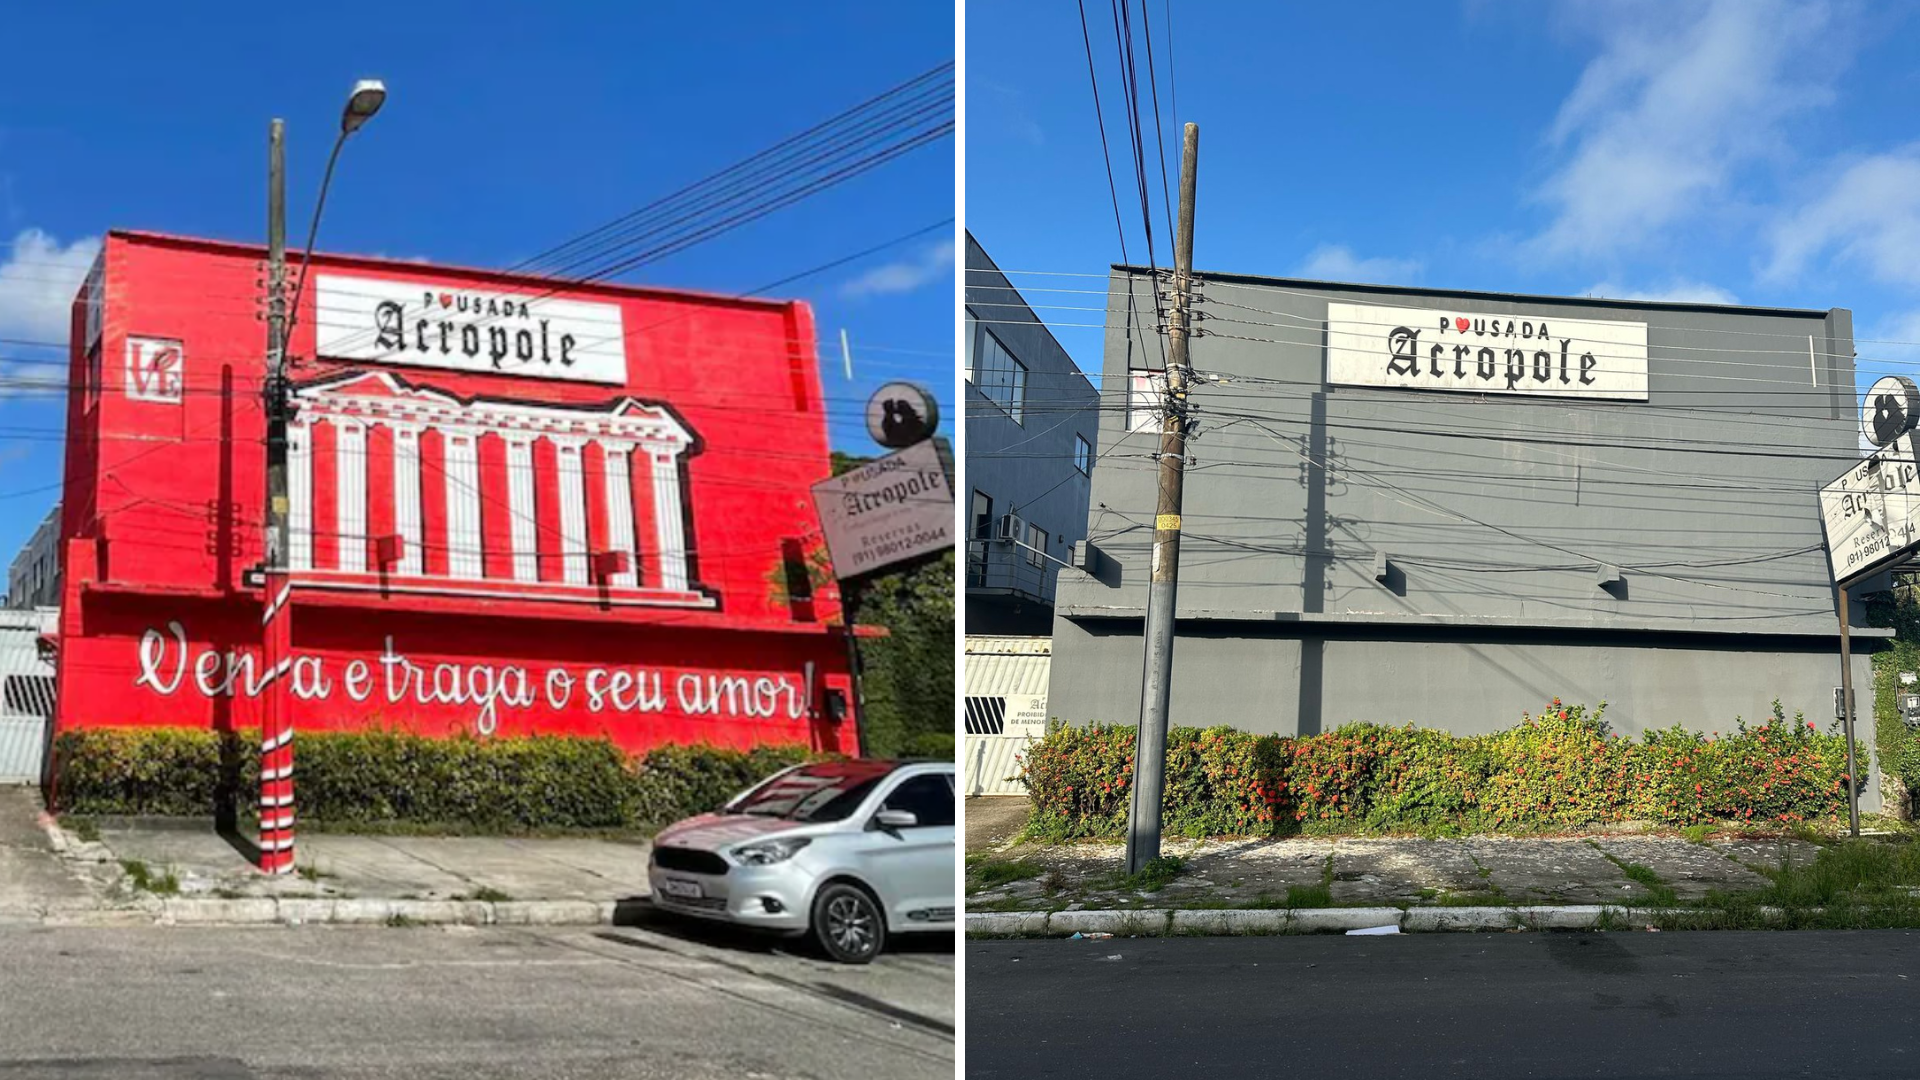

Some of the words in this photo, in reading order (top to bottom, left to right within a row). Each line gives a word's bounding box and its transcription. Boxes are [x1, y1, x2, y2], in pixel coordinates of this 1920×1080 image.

[374, 300, 577, 369] Acropole
[1386, 325, 1597, 391] Acropole
[843, 468, 940, 516] Acropole
[861, 523, 921, 548] Reservas
[852, 549, 876, 566] (91)
[1847, 549, 1864, 567] (91)
[136, 620, 332, 701] Vena
[344, 658, 374, 701] e
[379, 634, 537, 736] traga
[545, 667, 577, 710] o
[585, 668, 667, 713] seu
[1017, 711, 1046, 719] PROIBID
